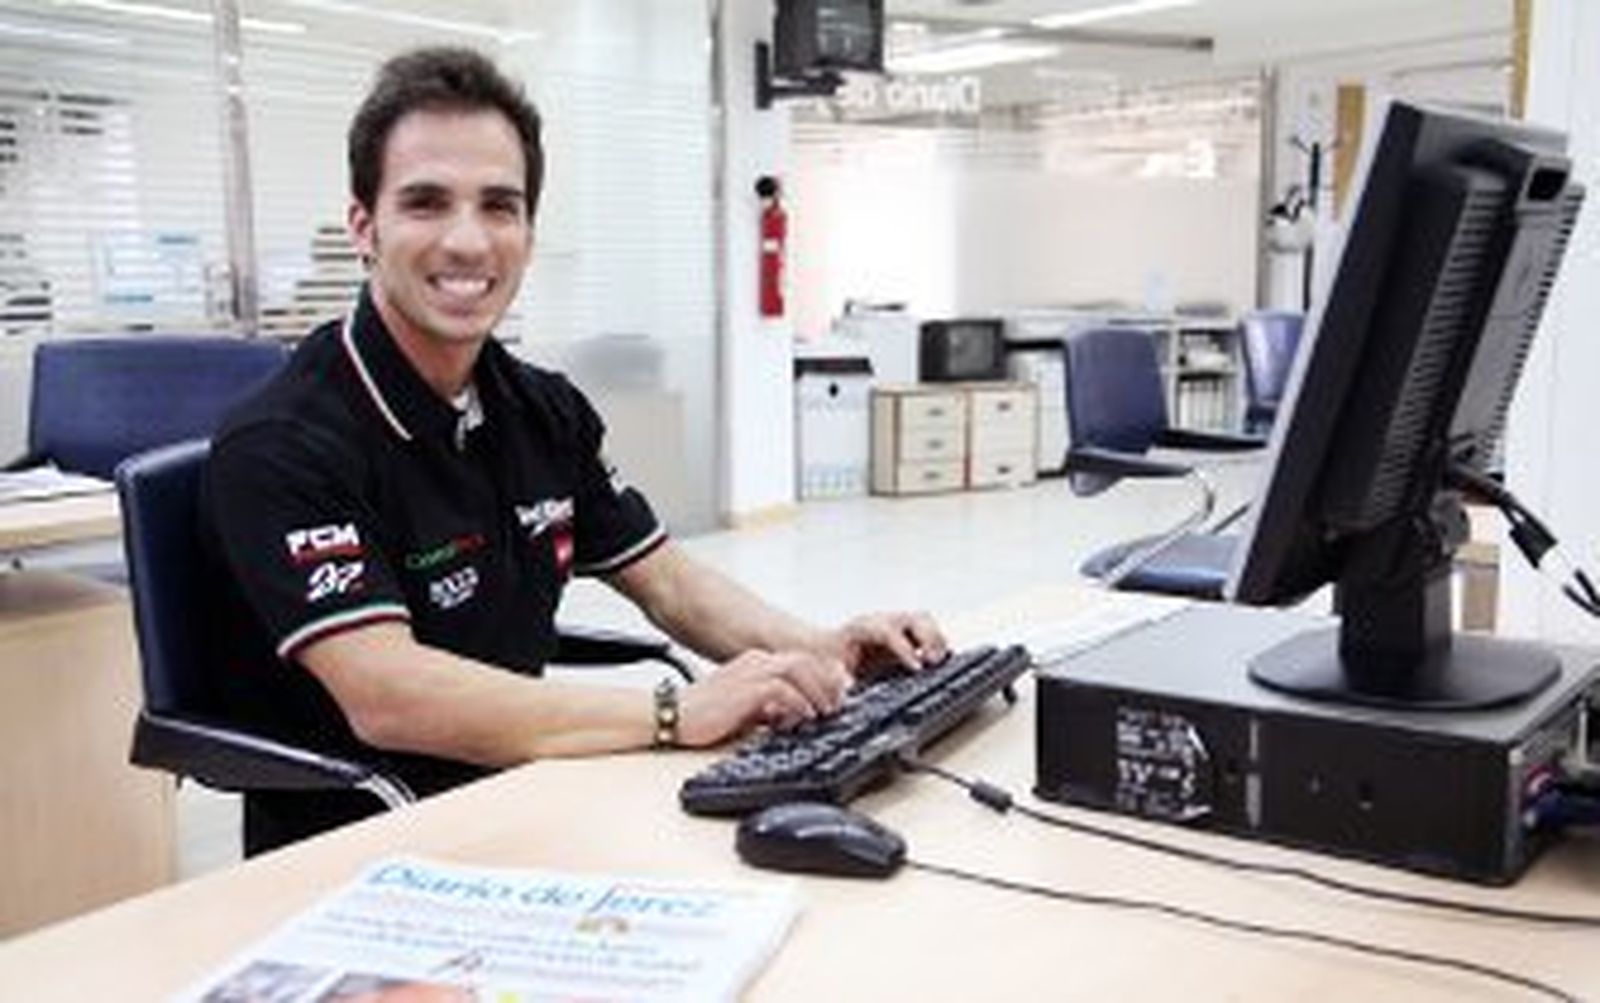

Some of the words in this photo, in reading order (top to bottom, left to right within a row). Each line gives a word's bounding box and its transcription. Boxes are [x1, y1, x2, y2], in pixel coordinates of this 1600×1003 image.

[367, 863, 512, 901] Diario
[519, 881, 585, 906] de
[588, 882, 726, 918] Jerez
